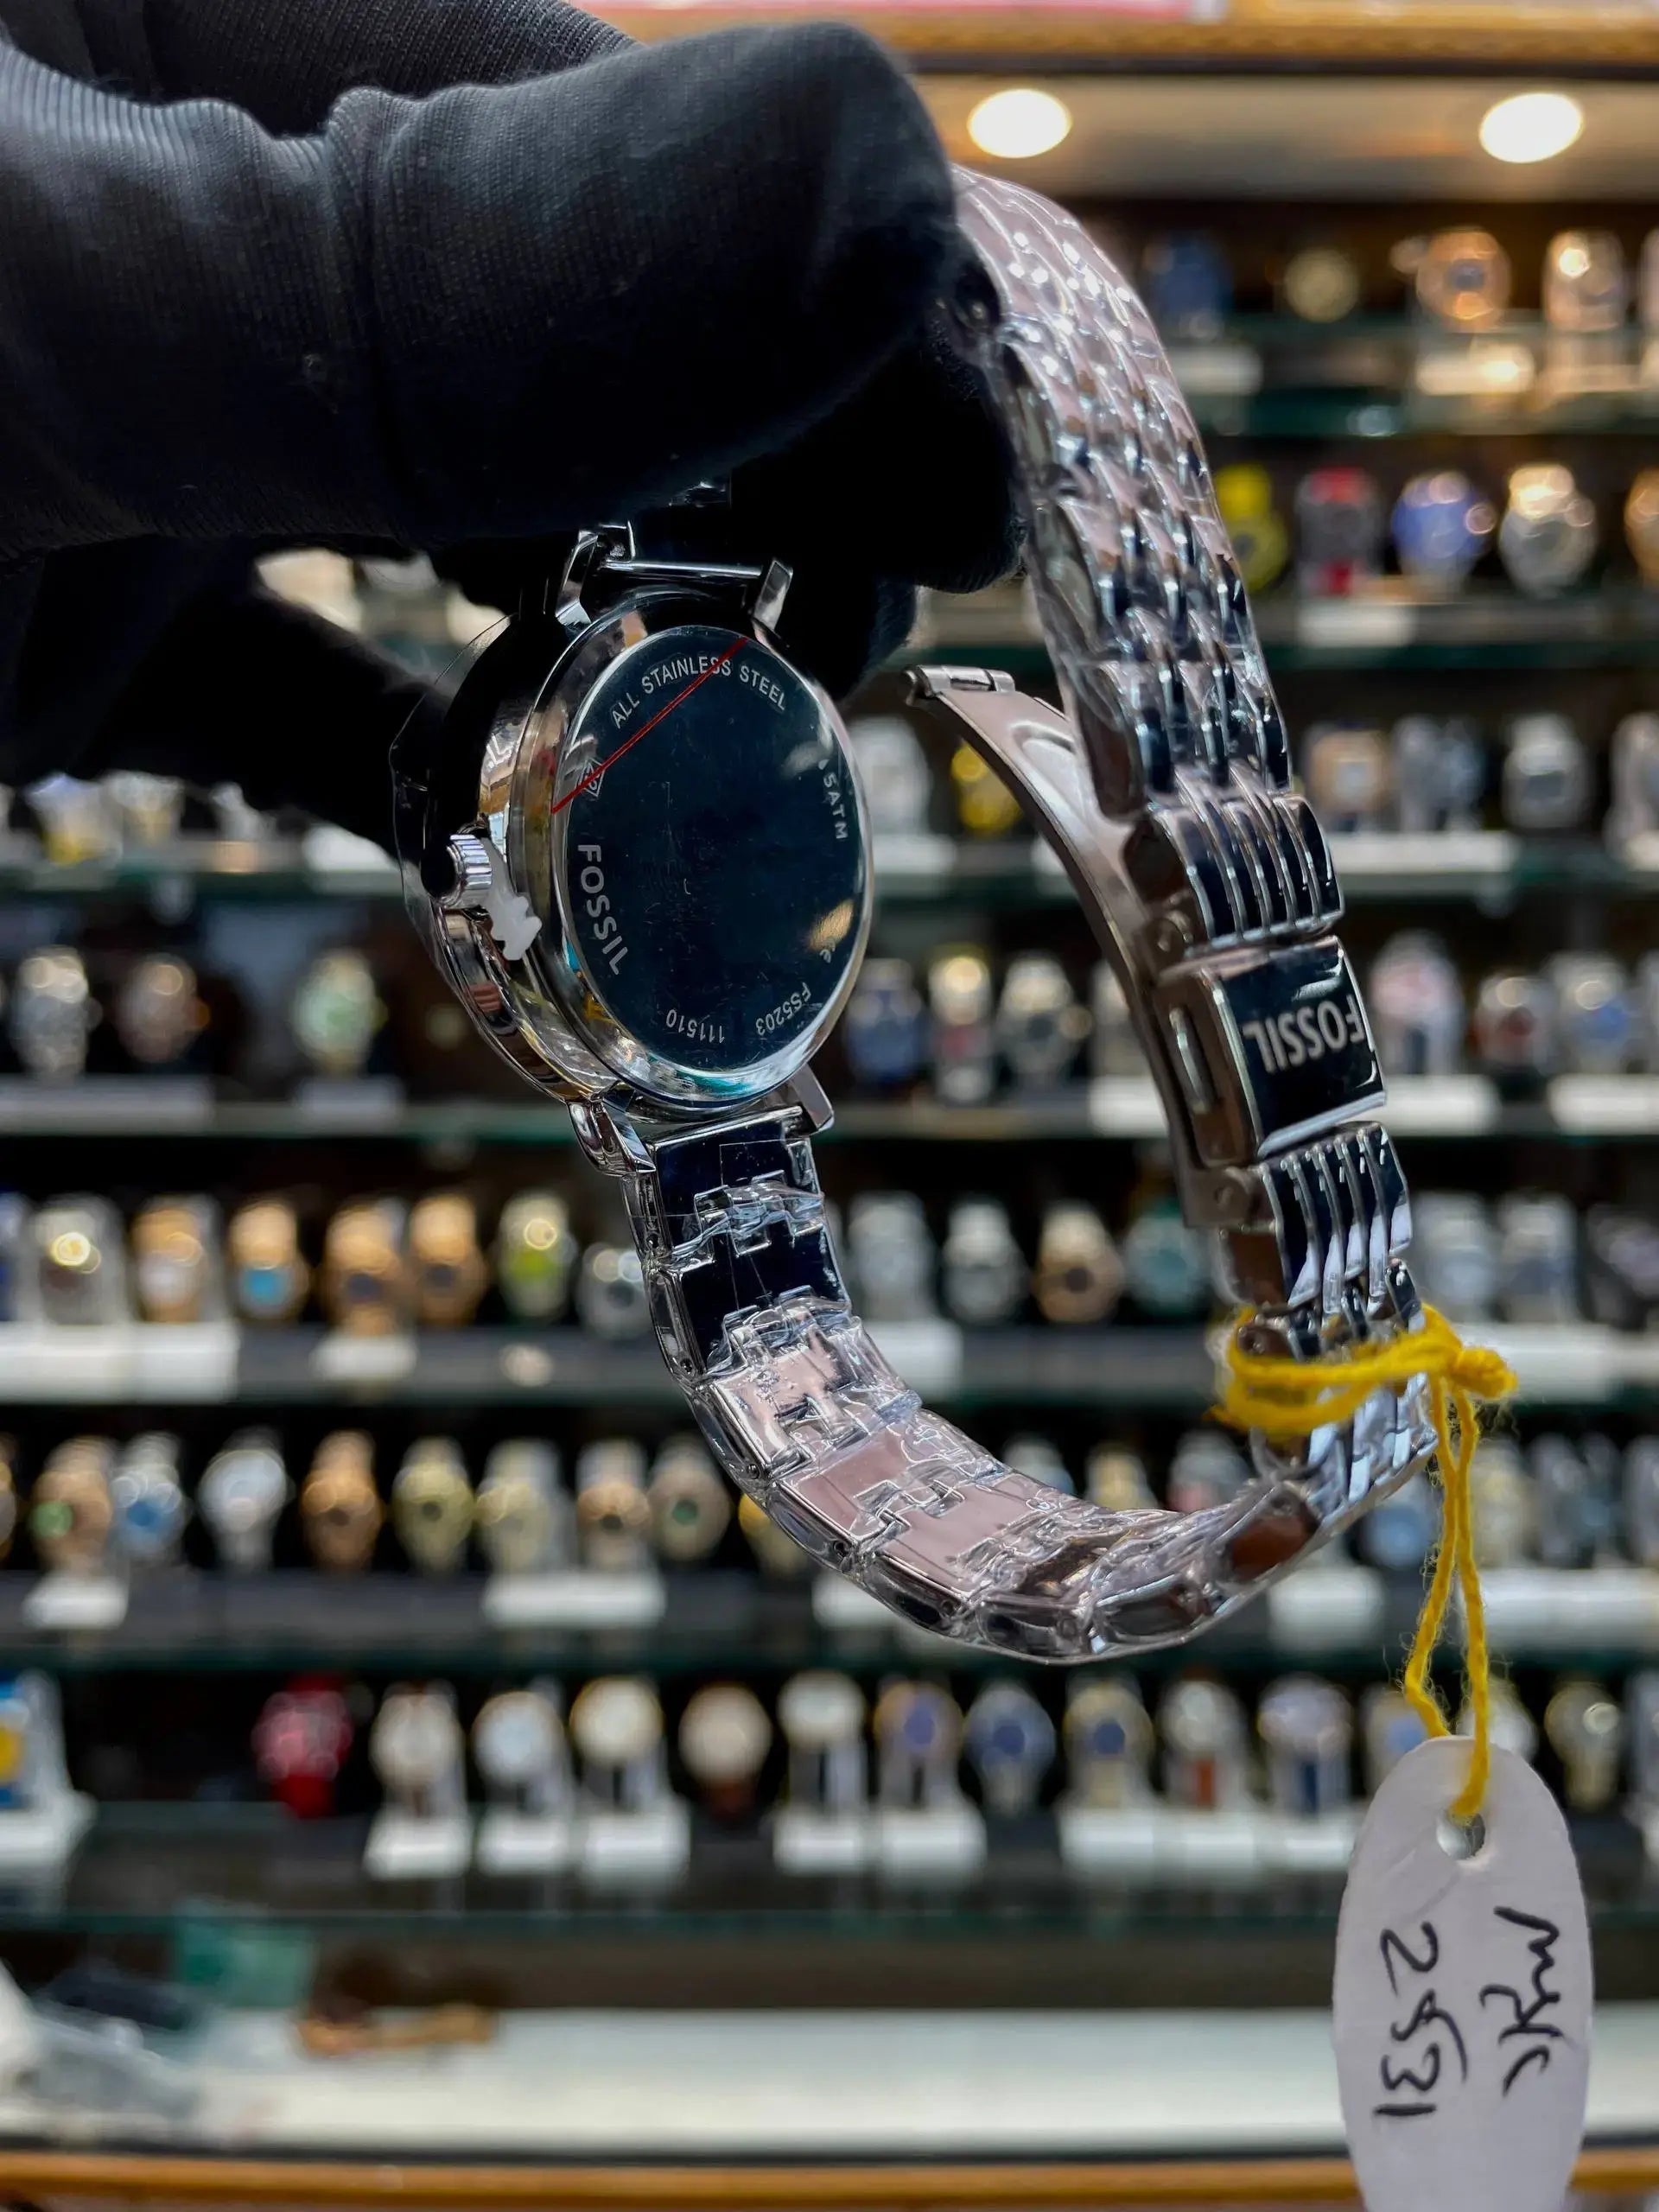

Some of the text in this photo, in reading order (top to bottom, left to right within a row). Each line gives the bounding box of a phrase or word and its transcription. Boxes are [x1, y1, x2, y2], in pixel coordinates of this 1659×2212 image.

[611, 656, 786, 729] ALL STAINLESS STEEL
[577, 843, 628, 976] FOSSIL
[666, 1008, 725, 1044] 111510
[755, 982, 812, 1036] FS5203
[1240, 994, 1365, 1074] FOSSIL
